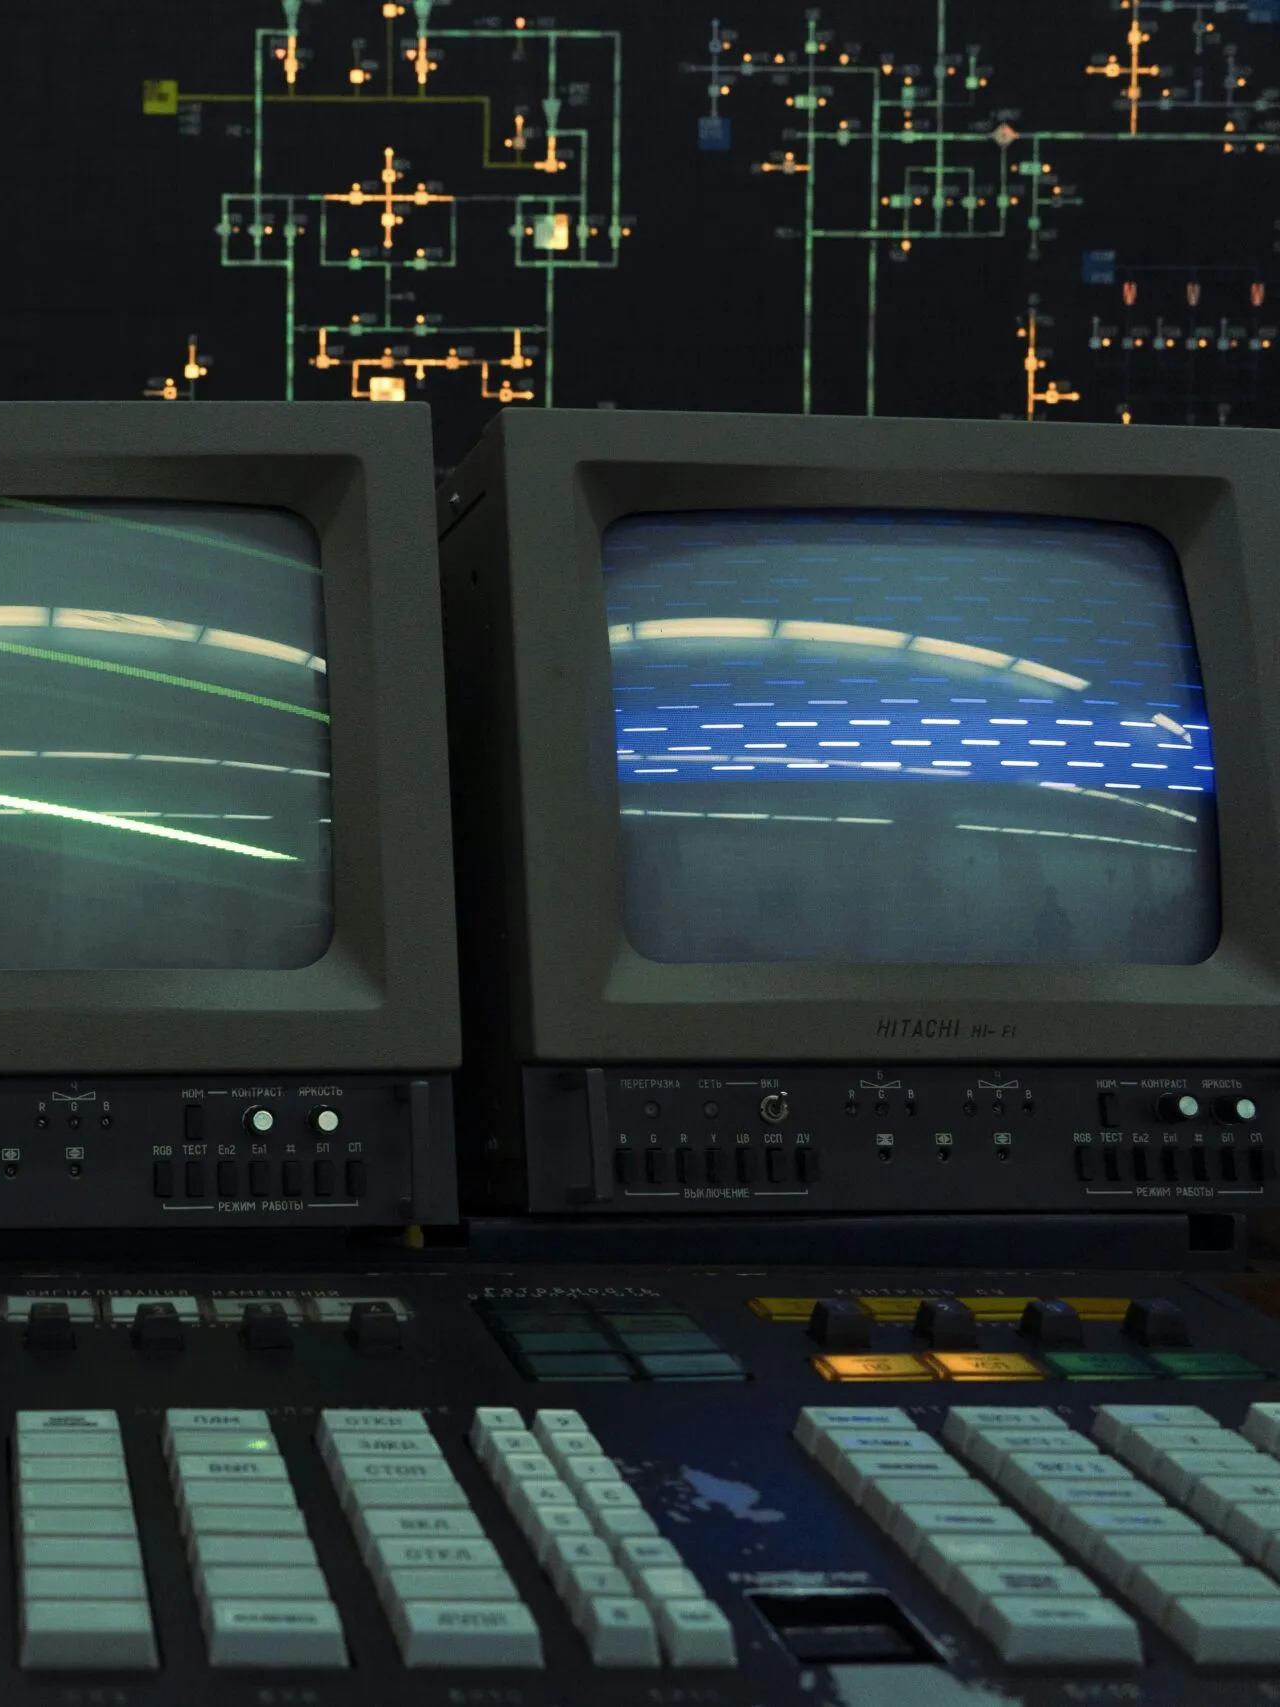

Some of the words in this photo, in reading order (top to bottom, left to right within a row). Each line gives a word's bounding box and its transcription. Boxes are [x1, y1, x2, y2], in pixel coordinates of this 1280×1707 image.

[876, 1019, 960, 1038] HITACHI
[620, 1078, 681, 1090] ПЕРЕГРУЗКА
[698, 1078, 723, 1089] СЕТЬ
[1201, 1079, 1243, 1089] ЯРКОСТЬ
[298, 1085, 343, 1097] ЯРКОСТЬ
[1073, 1132, 1092, 1143] RGB
[1100, 1132, 1124, 1143] ТЕСТ
[152, 1144, 172, 1156] RGB
[182, 1144, 208, 1156] ТЕСТ
[684, 1188, 750, 1200] ВЫКЛЮЧЕНИЕ
[1136, 1187, 1171, 1198] РЕЖИМ
[1176, 1187, 1214, 1197] РАБОТЫ
[218, 1201, 256, 1212] РЕЖИМ
[261, 1200, 303, 1212] РАБОТЫ
